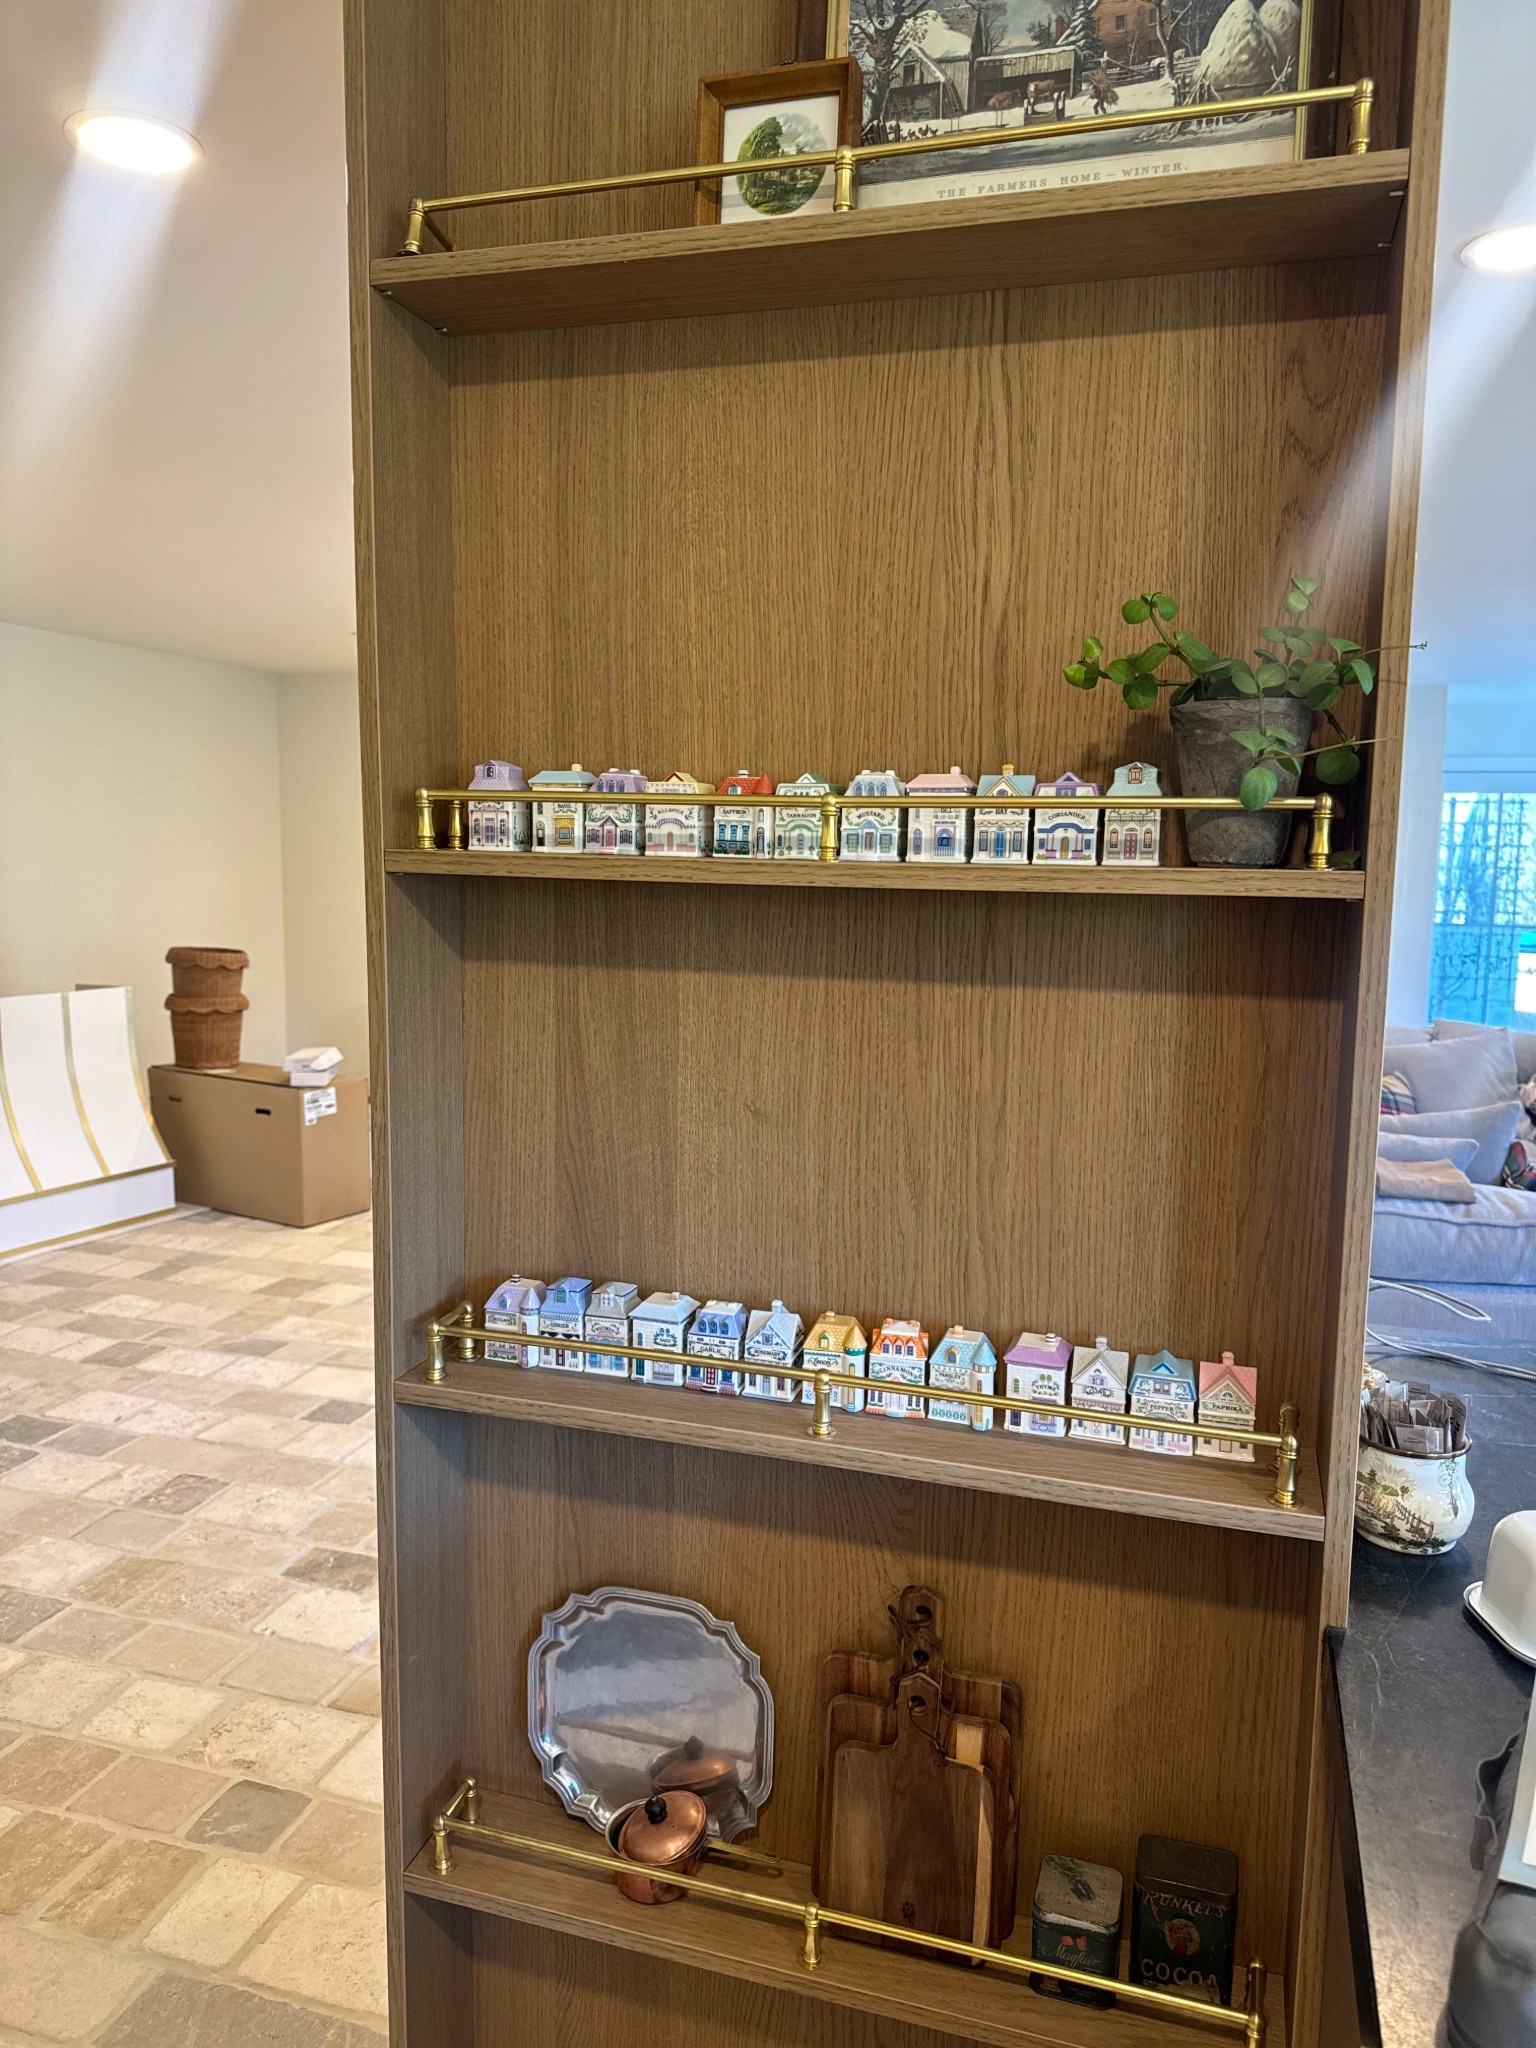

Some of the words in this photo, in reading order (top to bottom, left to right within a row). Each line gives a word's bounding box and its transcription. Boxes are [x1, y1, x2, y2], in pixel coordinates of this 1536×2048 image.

[937, 187, 966, 199] THE
[978, 178, 1047, 195] FARMERS
[1060, 172, 1101, 185] HOME
[1121, 162, 1188, 178] WINTER.
[657, 807, 684, 815] ALLSPICE
[856, 811, 885, 820] MUSTARD
[1047, 811, 1087, 821] CORIANDER
[700, 1346, 722, 1354] GARLIC
[754, 1349, 781, 1357] ROSEMARY
[814, 1358, 832, 1367] ONION
[879, 1366, 915, 1377] CINNAMON
[1150, 1404, 1174, 1412] PEPPER
[1212, 1403, 1243, 1412] PAPRIKA
[1041, 1943, 1102, 1968] Mayfair
